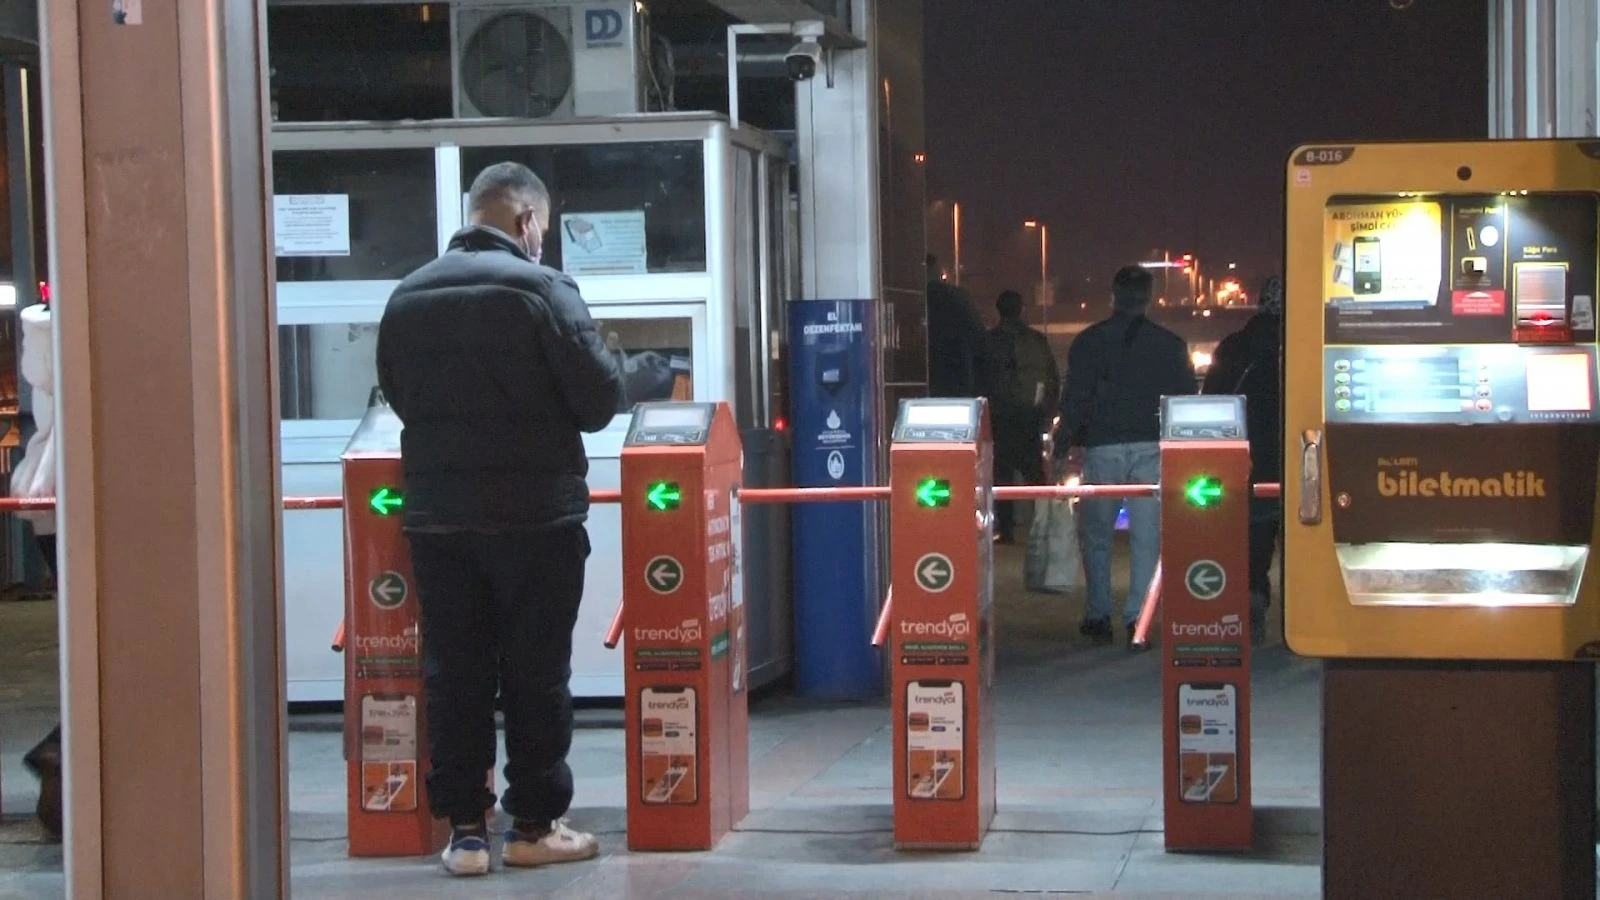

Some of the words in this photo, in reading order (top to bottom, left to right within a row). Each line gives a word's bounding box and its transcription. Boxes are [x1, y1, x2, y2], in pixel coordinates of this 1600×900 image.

[1350, 221, 1378, 232] ŞİMDİ
[1377, 470, 1546, 497] biletmatik
[634, 624, 702, 643] trendyol
[900, 619, 970, 638] trendyol
[1172, 621, 1242, 640] trendyol
